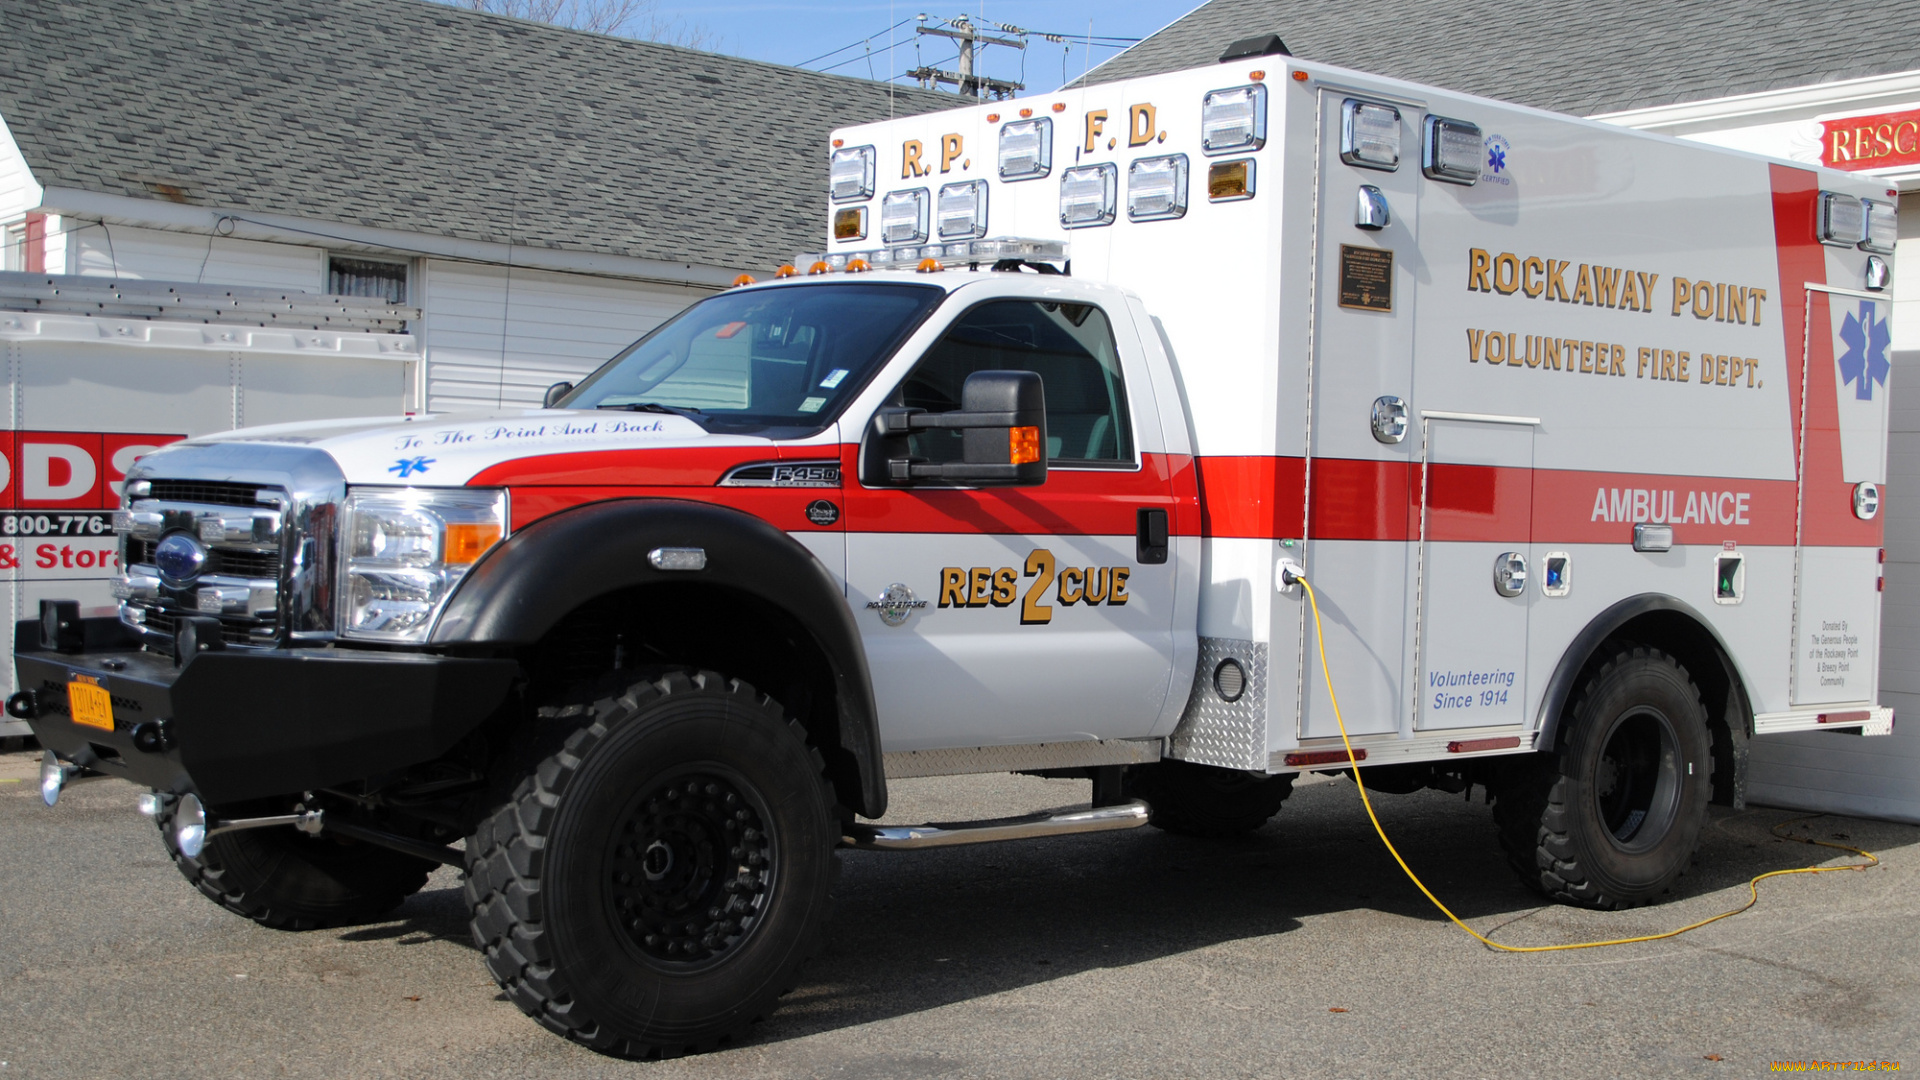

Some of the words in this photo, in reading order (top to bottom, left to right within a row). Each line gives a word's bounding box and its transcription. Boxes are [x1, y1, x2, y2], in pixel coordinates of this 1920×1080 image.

[1482, 174, 1510, 186] CERTIFIED
[1467, 248, 1659, 313] ROCKAWAY
[1671, 277, 1767, 327] POINT
[1466, 328, 1626, 377] VOLUNTEER
[1637, 347, 1690, 383] FIRE
[1700, 353, 1763, 389] DEPT.
[394, 434, 424, 450] To
[433, 430, 476, 445] The
[484, 426, 546, 440] Point
[552, 422, 598, 436] And
[605, 420, 665, 433] Back
[1591, 488, 1750, 526] AMBULANCE
[36, 543, 119, 568] Stor
[1822, 620, 1841, 631] Donated
[1842, 620, 1848, 632] By
[1811, 634, 1820, 645] The
[1821, 634, 1842, 645] Generous
[1843, 633, 1858, 646] People
[1809, 648, 1814, 659] of
[1815, 648, 1823, 659] the
[1824, 648, 1846, 660] Rockaway
[1847, 647, 1859, 658] Point
[1817, 662, 1821, 672] &
[1822, 662, 1837, 673] Breezy
[1838, 661, 1850, 671] Point
[1430, 668, 1515, 687] Volunteering
[1820, 675, 1845, 687] Community
[1433, 693, 1473, 709] Since
[1479, 690, 1508, 706] 1914
